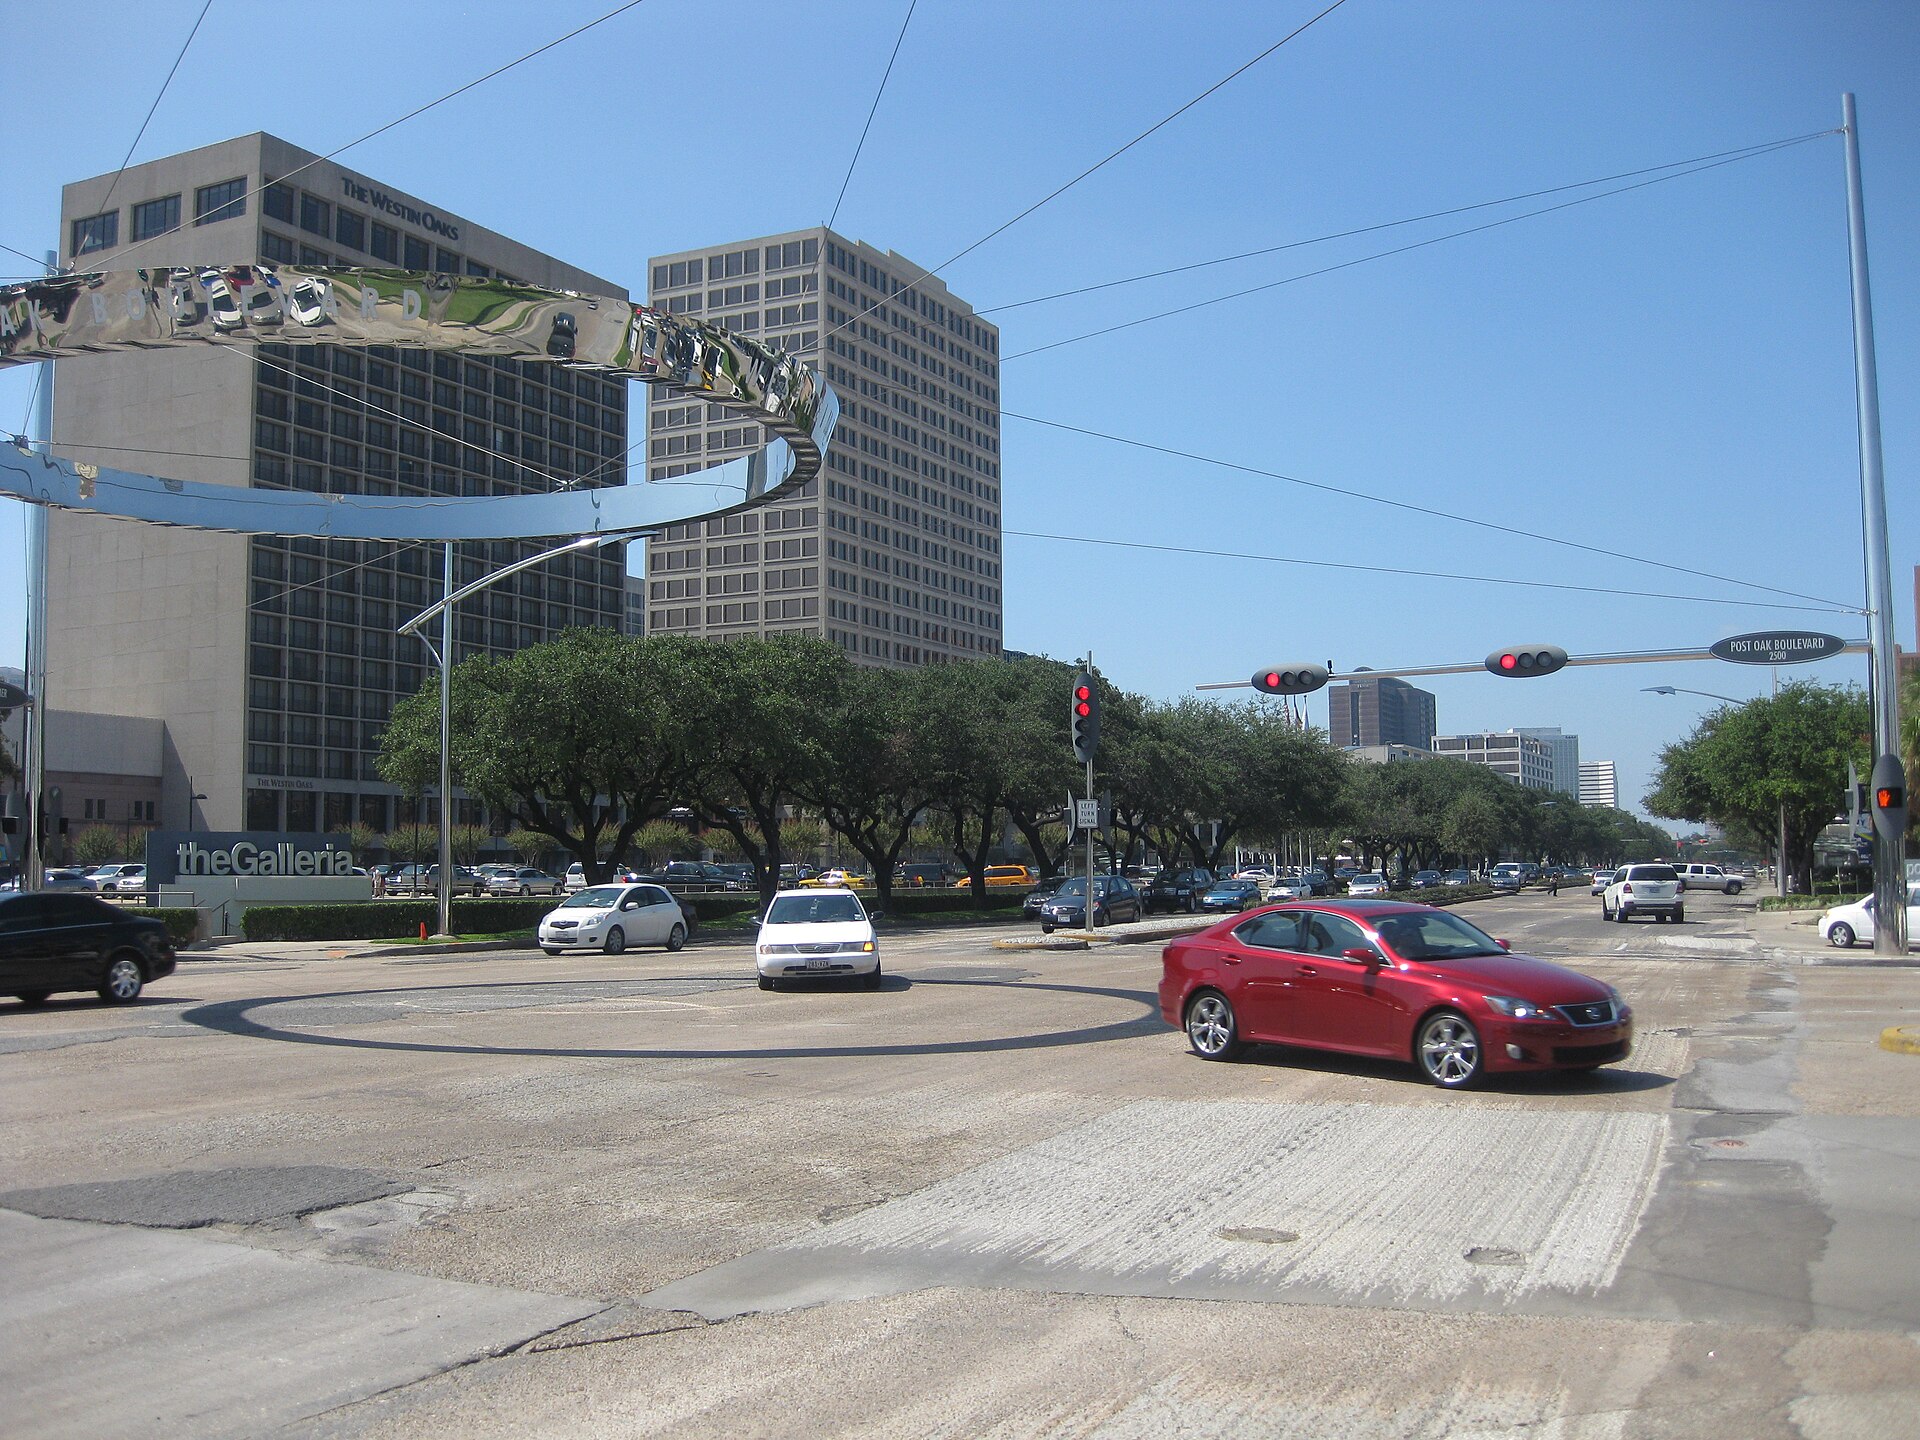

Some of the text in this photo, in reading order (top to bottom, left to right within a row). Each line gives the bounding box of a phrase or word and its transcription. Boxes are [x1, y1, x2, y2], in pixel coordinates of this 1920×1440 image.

[342, 177, 459, 240] THE WESTIN OAKS
[91, 284, 422, 325] BOULEVARD
[1730, 637, 1825, 652] POST OAK BOULEVARD
[1768, 651, 1787, 661] 2500
[257, 778, 270, 787] THE
[177, 841, 354, 875] theGalleria
